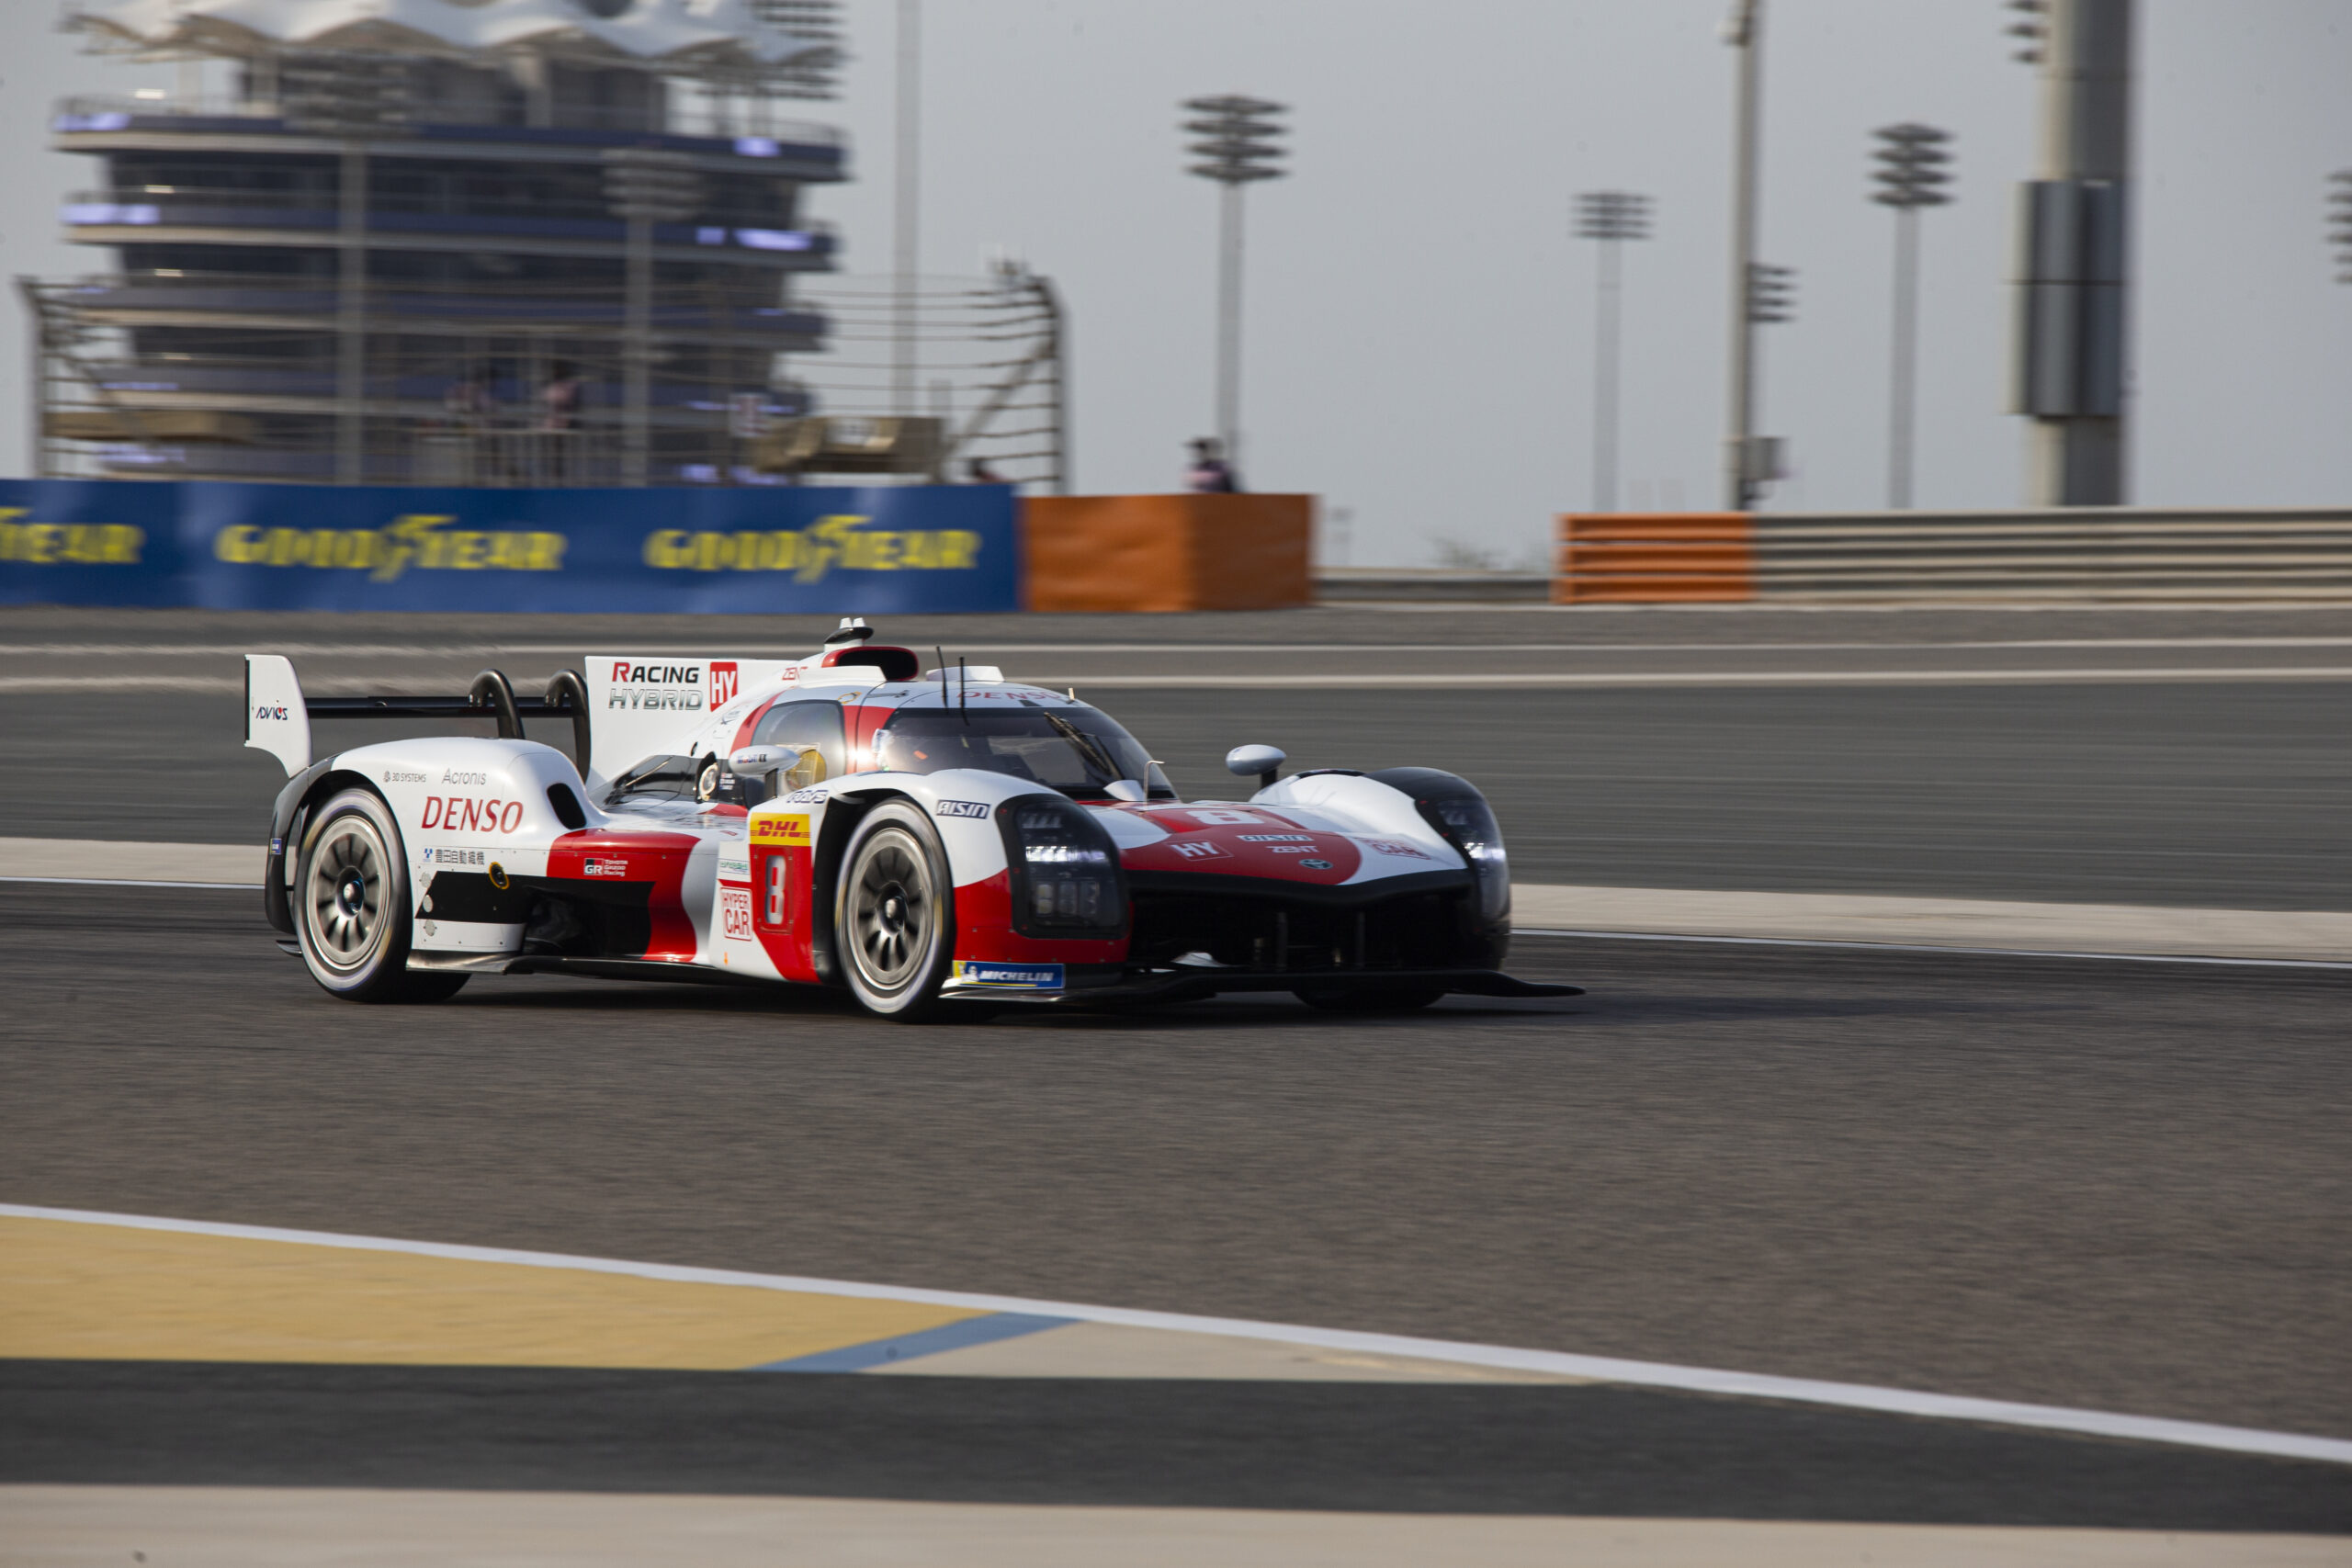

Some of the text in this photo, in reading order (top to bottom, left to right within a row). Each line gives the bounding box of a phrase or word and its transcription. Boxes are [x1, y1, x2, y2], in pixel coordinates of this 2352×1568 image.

[216, 515, 567, 580] GOODYEAR
[645, 515, 980, 581] GOODYEAR
[612, 662, 699, 682] RACING
[711, 671, 736, 704] HY
[957, 691, 1060, 700] DENSO
[608, 688, 703, 710] HYBRID
[391, 773, 426, 783] 3D SYSTEMS
[442, 768, 486, 784] Acronis
[421, 795, 524, 834] DENSO
[937, 801, 988, 818] AISIN
[1185, 810, 1265, 826] 8
[758, 820, 802, 838] DHL
[1170, 841, 1219, 857] HY
[1266, 845, 1319, 853] ZENT
[584, 864, 603, 874] GR
[765, 855, 786, 925] 8
[722, 892, 750, 909] HYPER
[725, 908, 750, 935] CAR
[979, 970, 1054, 981] MICHELIN
